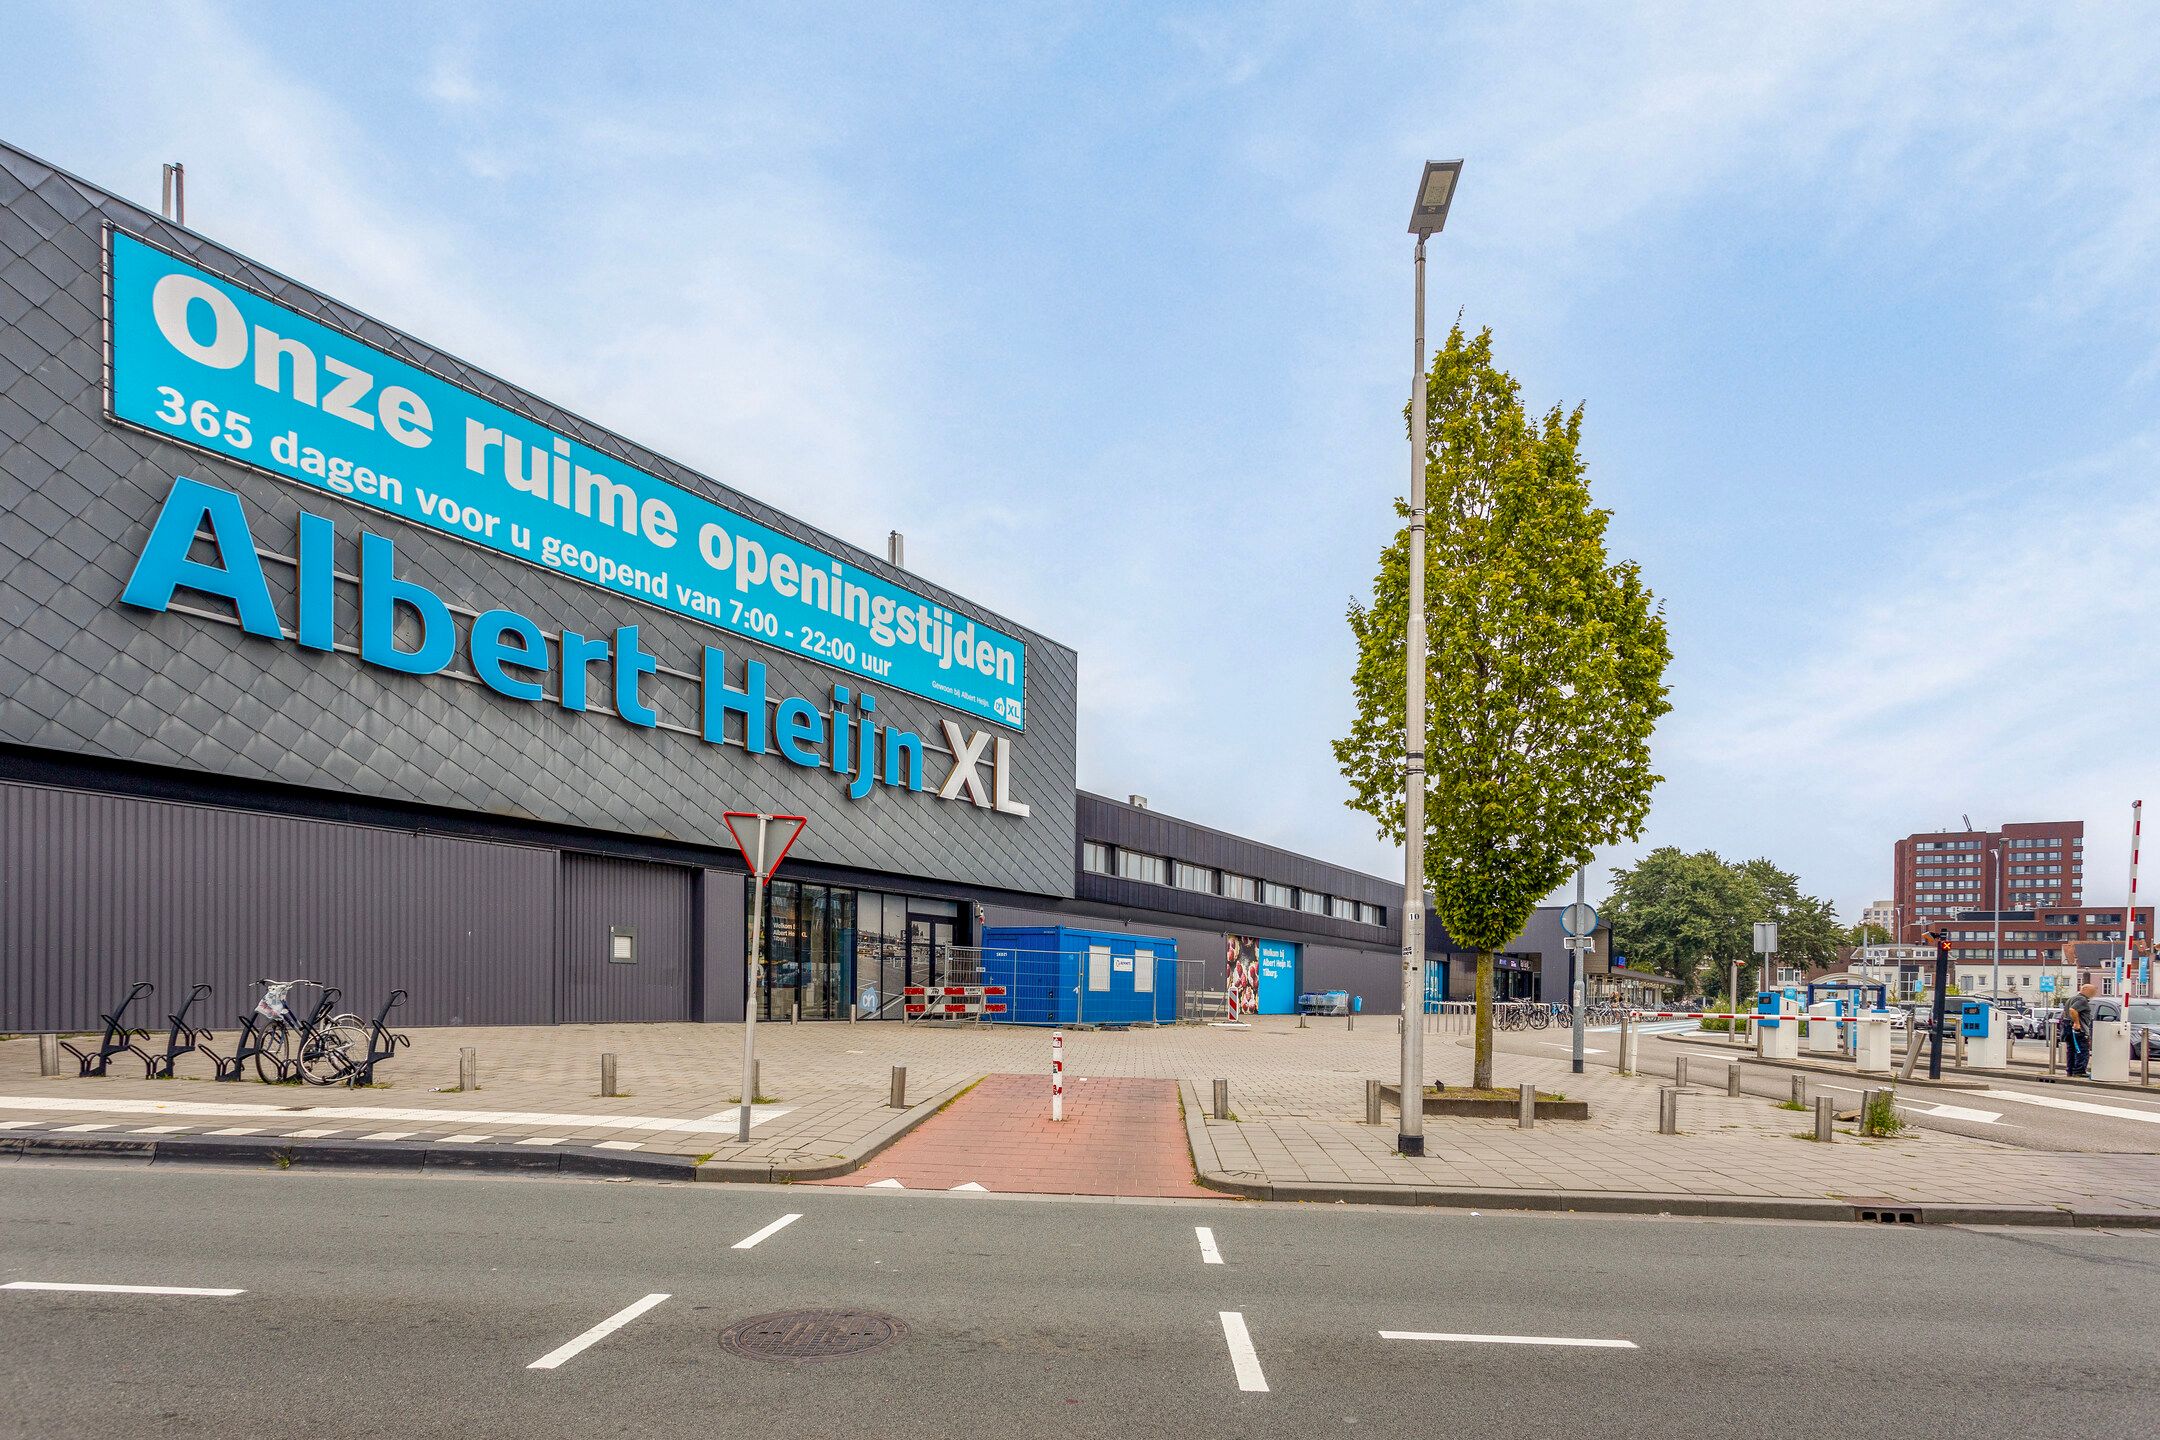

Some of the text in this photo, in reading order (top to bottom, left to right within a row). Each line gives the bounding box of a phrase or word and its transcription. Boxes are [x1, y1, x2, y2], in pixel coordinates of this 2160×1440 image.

[153, 273, 1016, 686] Onze ruime openingstijden
[155, 385, 892, 678] 365 dagen voor u geopend van 7:00 - 22:00 uur
[119, 475, 1030, 818] Albert Heijn XL
[931, 680, 954, 694] Gewoon
[953, 688, 961, 699] bij
[961, 691, 977, 703] Albert
[1007, 703, 1020, 719] XL
[1263, 958, 1276, 967] Albert
